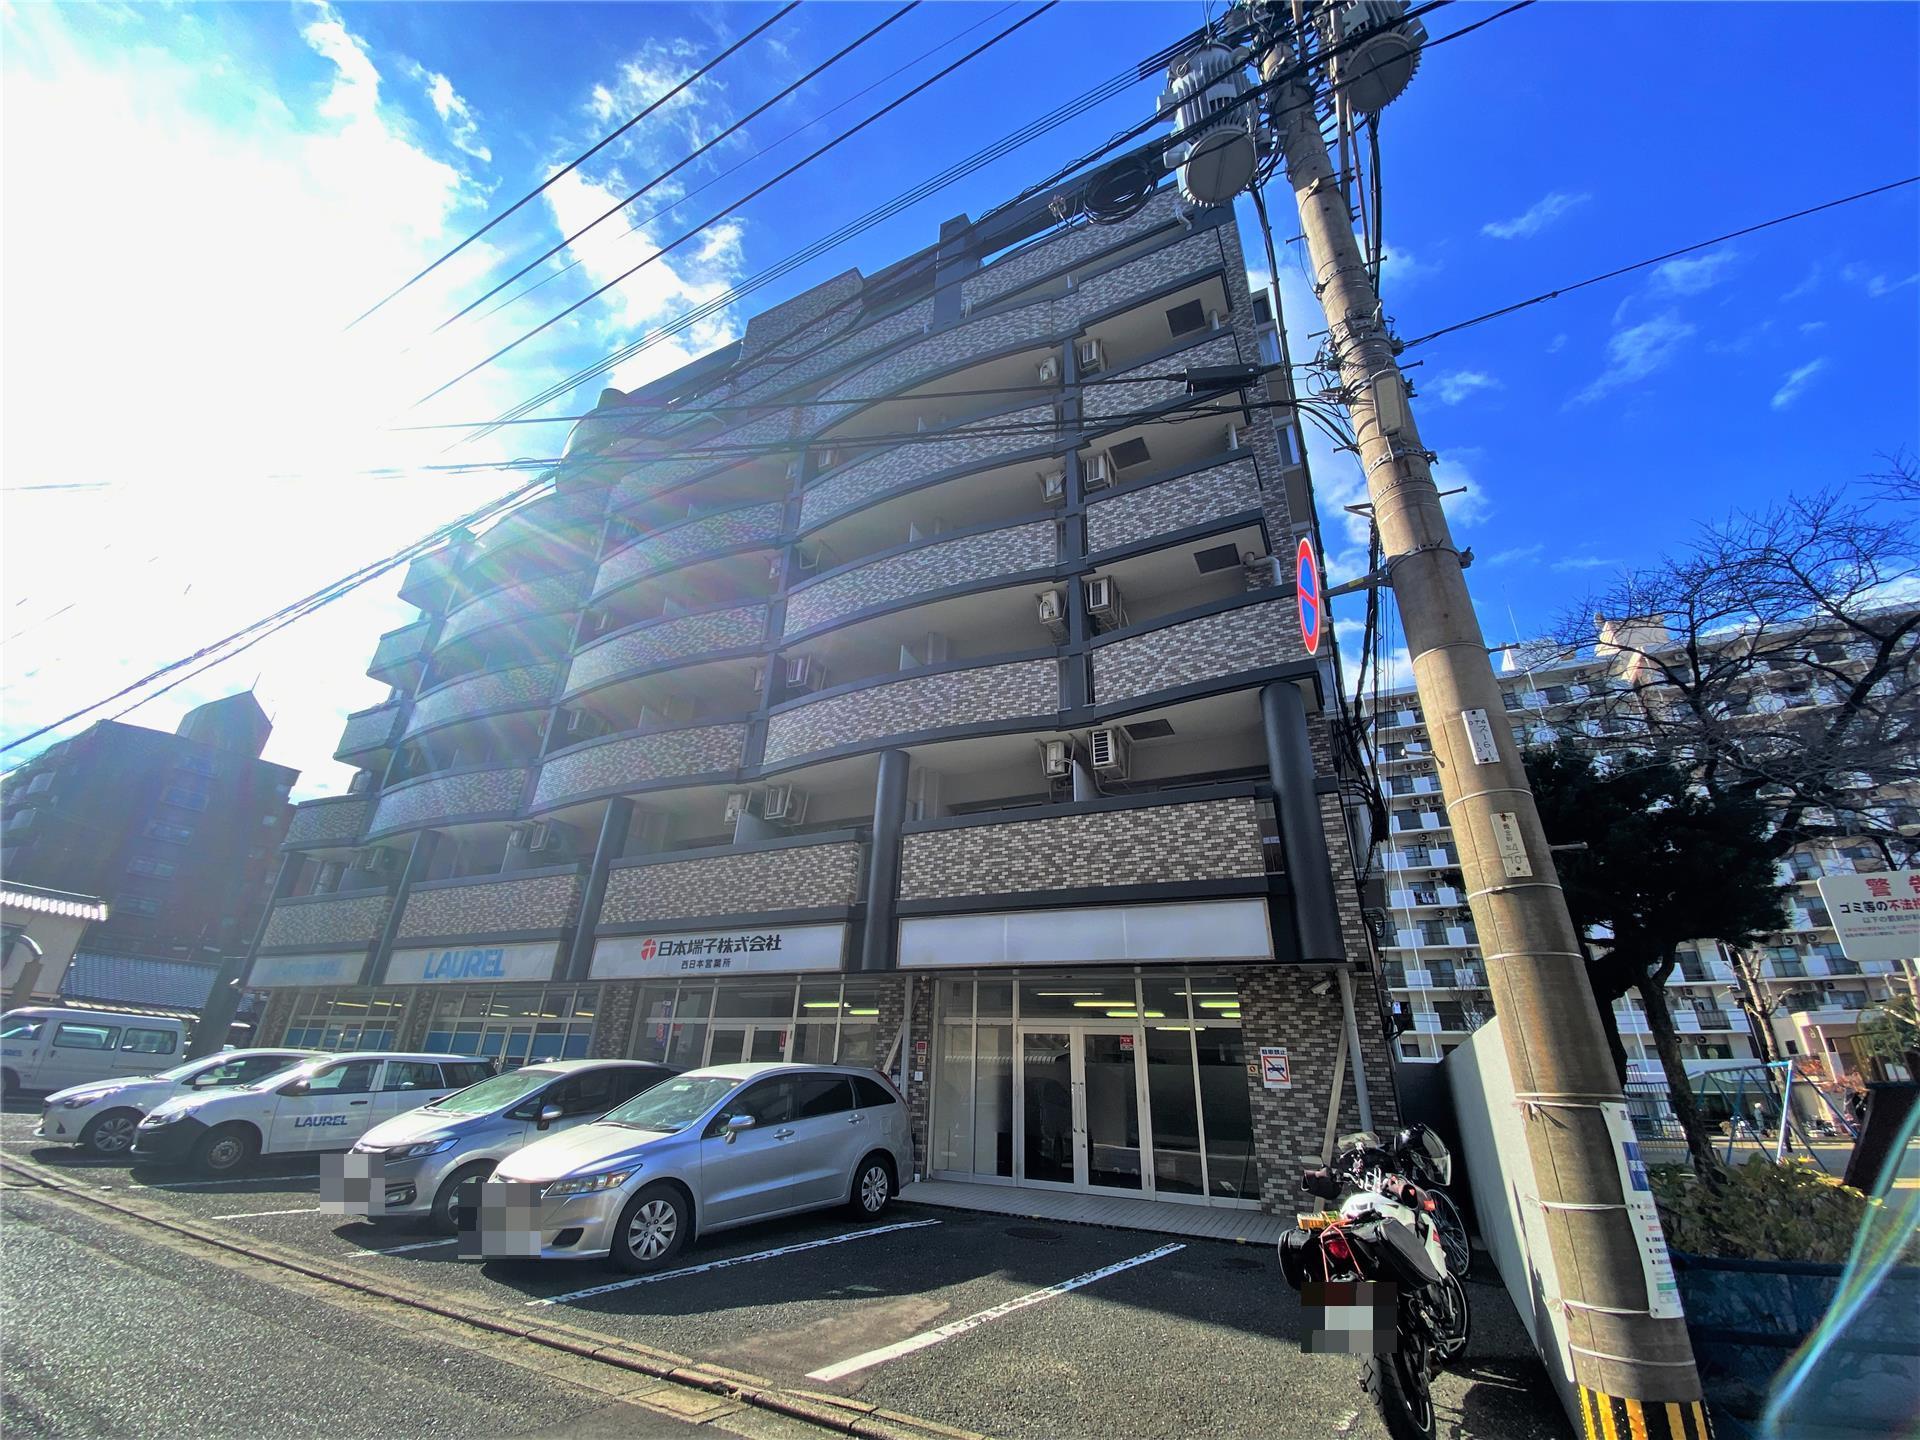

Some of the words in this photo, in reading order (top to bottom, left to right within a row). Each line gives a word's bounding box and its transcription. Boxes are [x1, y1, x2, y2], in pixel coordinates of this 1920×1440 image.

[658, 934, 782, 957] 日本端子株式会社
[423, 948, 505, 979] LAUREL
[681, 958, 731, 970] 西日本営業所
[294, 1115, 348, 1128] LAUREL
